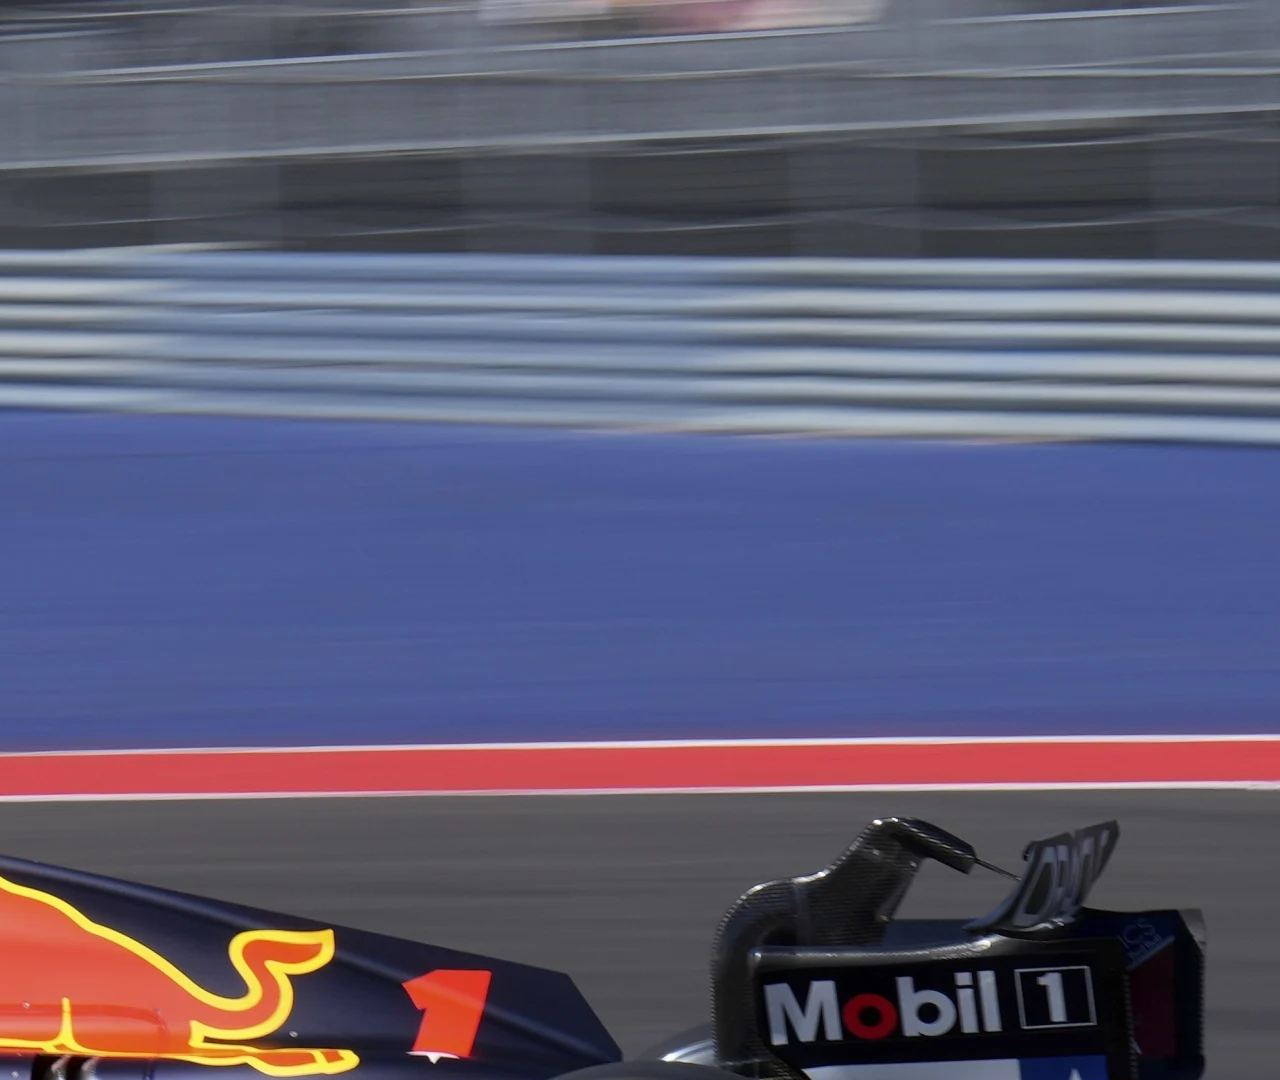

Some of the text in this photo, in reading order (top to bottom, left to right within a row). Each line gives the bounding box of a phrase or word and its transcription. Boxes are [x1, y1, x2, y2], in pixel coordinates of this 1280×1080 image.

[402, 969, 492, 1058] 1
[764, 970, 1069, 1046] Mobil 1
